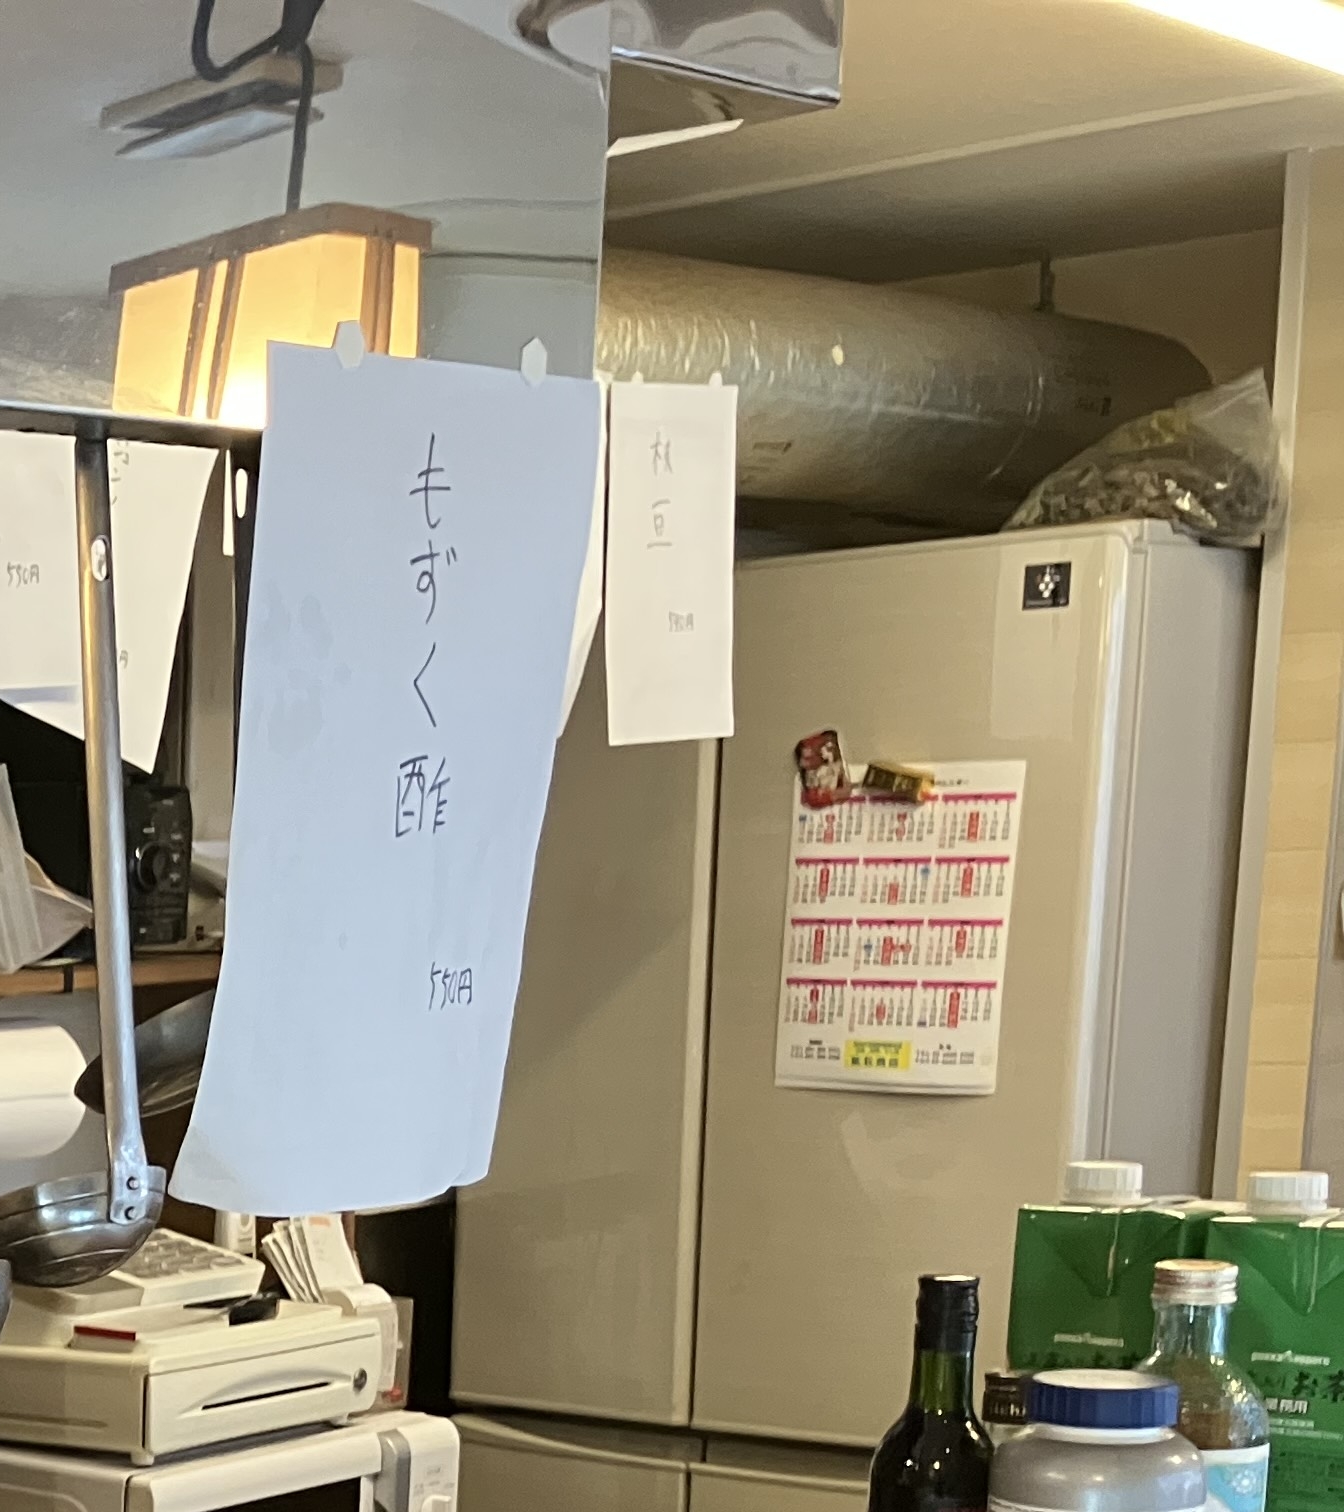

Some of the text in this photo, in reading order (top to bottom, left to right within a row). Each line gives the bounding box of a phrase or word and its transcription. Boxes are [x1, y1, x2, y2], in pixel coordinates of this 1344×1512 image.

[394, 433, 458, 838] もずく酢
[428, 962, 474, 1011] 550円
